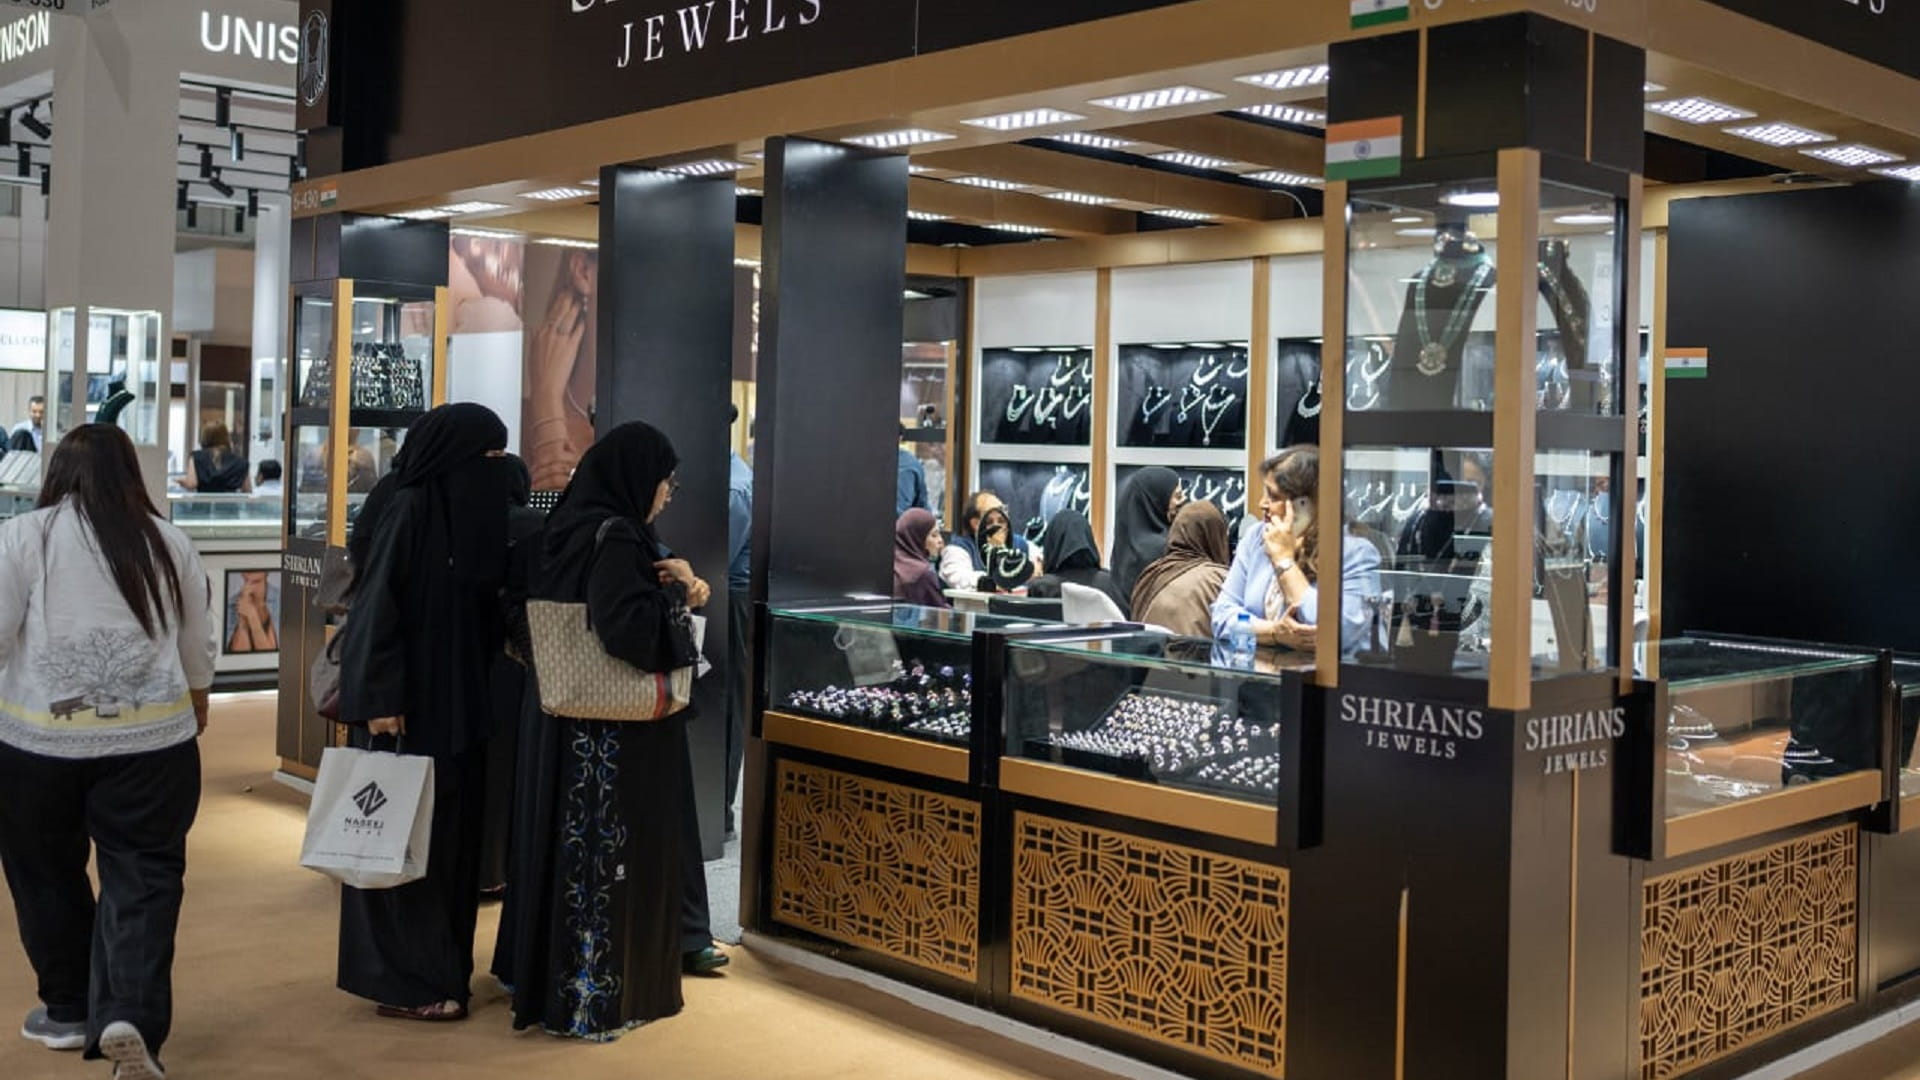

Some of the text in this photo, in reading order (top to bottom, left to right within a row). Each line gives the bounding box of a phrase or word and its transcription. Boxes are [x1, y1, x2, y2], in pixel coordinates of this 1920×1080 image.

[0, 10, 50, 63] NISON
[617, 0, 820, 68] JEWELS
[1340, 693, 1483, 740] SHRIANS
[1525, 706, 1626, 752] SHRIANS
[1366, 729, 1456, 759] JEWELS
[1544, 749, 1608, 775] JEWELS
